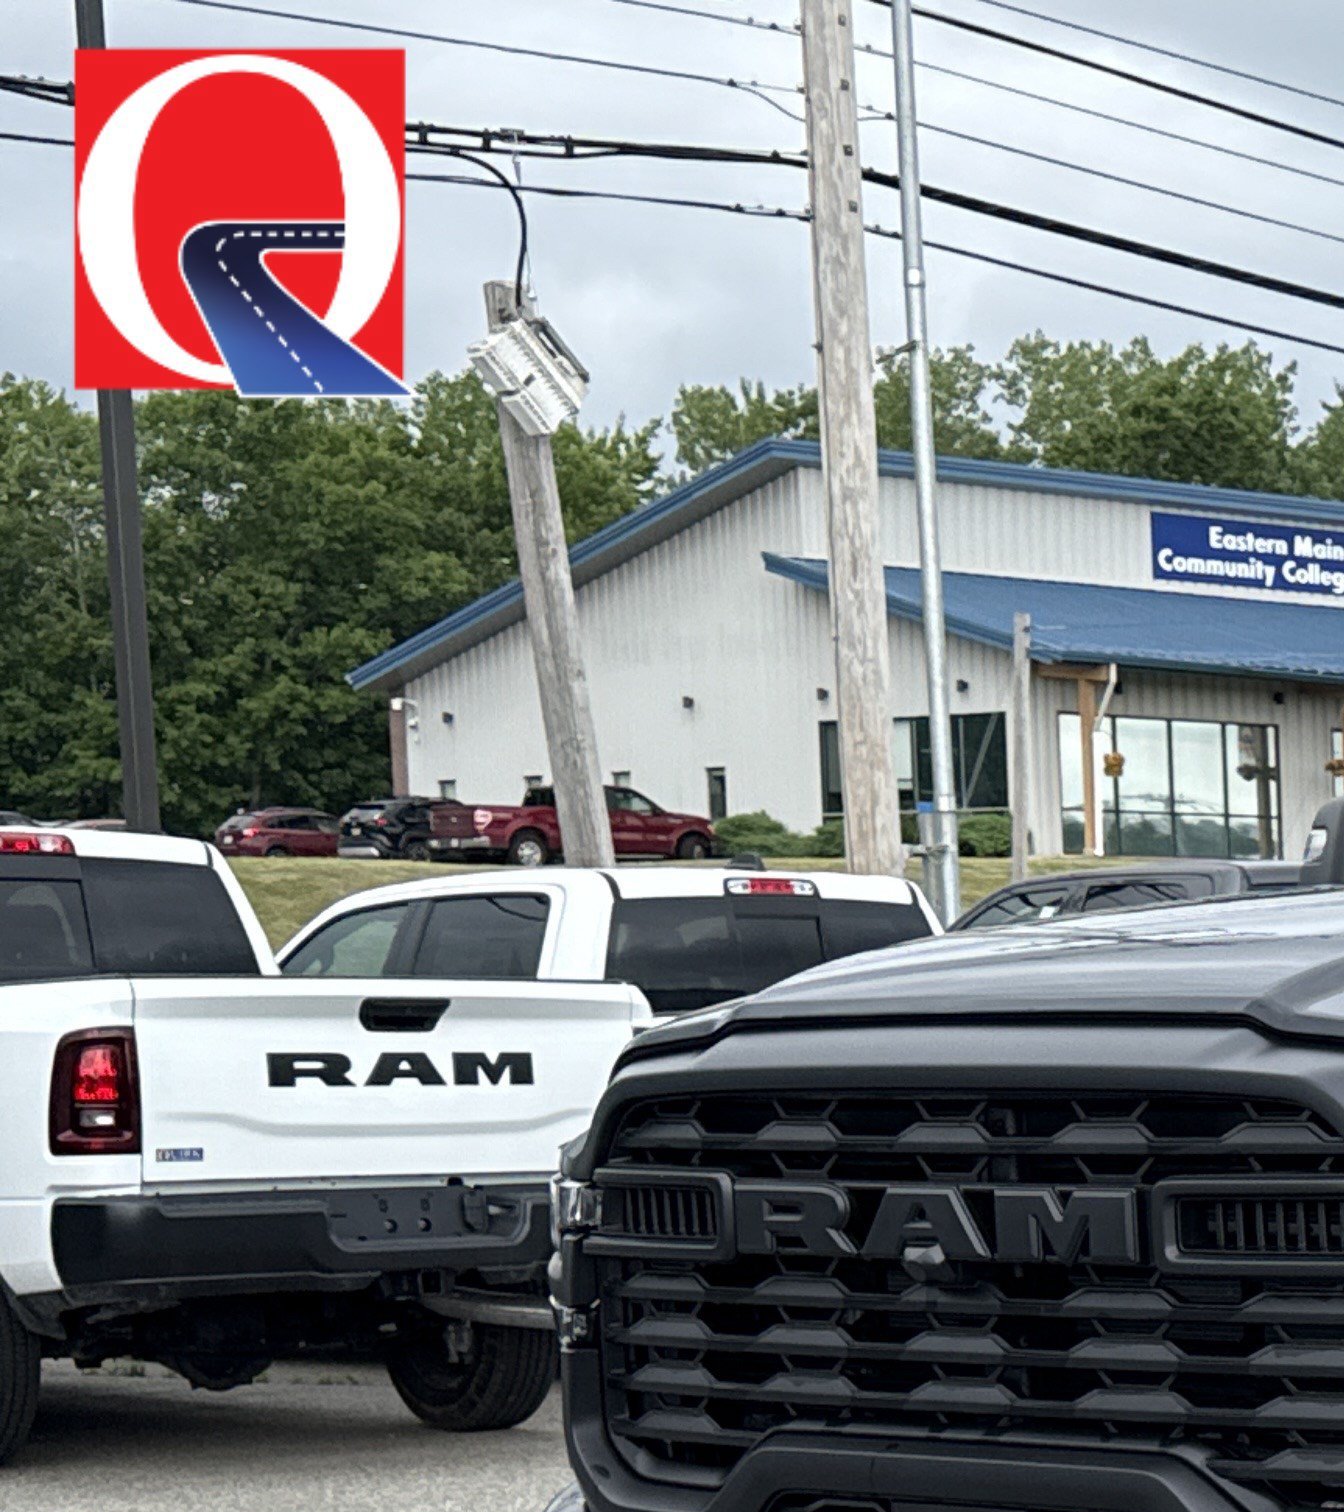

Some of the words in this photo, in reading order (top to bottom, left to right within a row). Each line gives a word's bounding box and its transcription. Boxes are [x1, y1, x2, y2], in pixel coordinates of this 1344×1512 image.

[1208, 525, 1289, 556] Eastern
[1157, 547, 1277, 588] Community
[266, 1051, 535, 1088] RAM
[735, 1184, 1138, 1265] RAM
